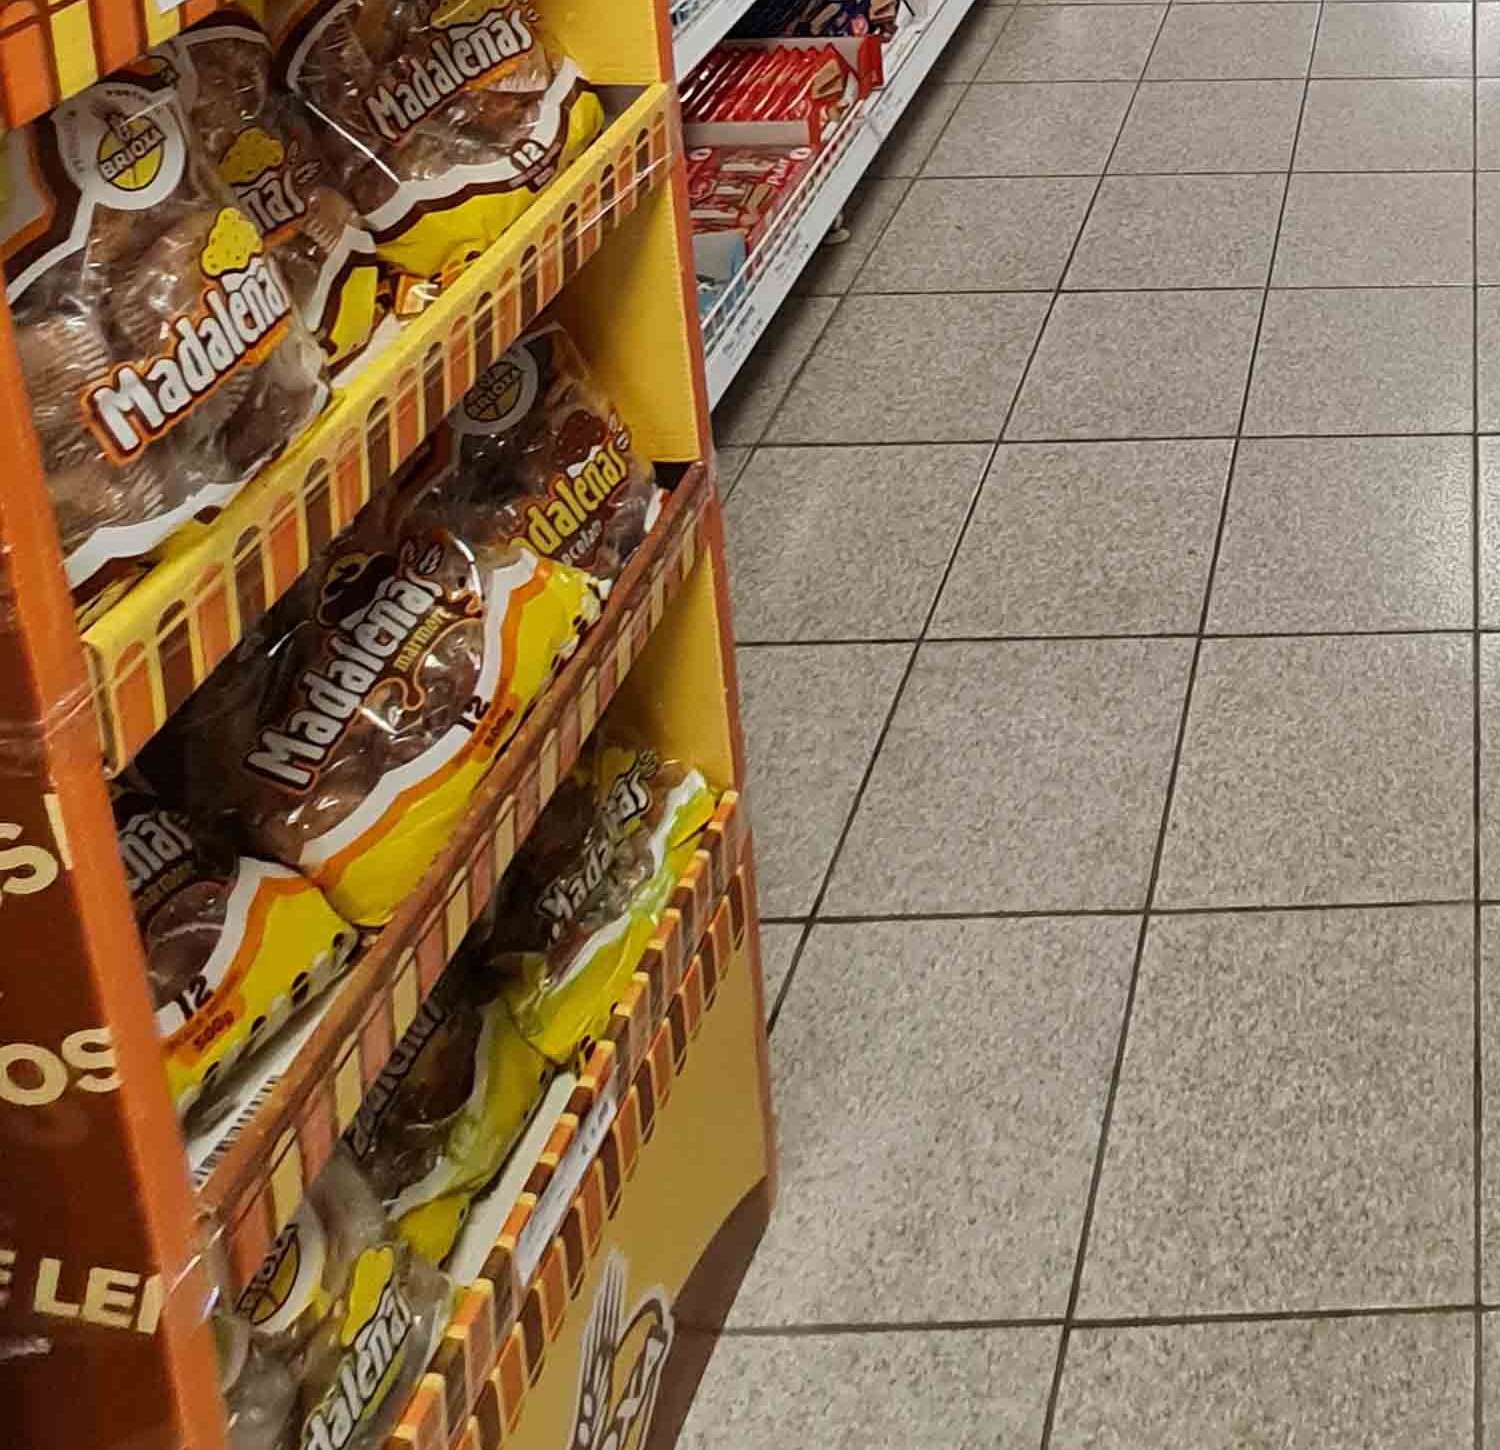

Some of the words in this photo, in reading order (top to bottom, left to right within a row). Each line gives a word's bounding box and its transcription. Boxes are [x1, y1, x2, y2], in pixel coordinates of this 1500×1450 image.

[366, 9, 534, 142] Madalenas
[98, 127, 167, 180] BRIOXA
[515, 144, 542, 167] 12
[92, 259, 293, 450] Madalena
[509, 440, 628, 555] dalenas
[247, 568, 445, 790] Madalenas
[460, 694, 492, 732] 12
[180, 974, 208, 1022] 12
